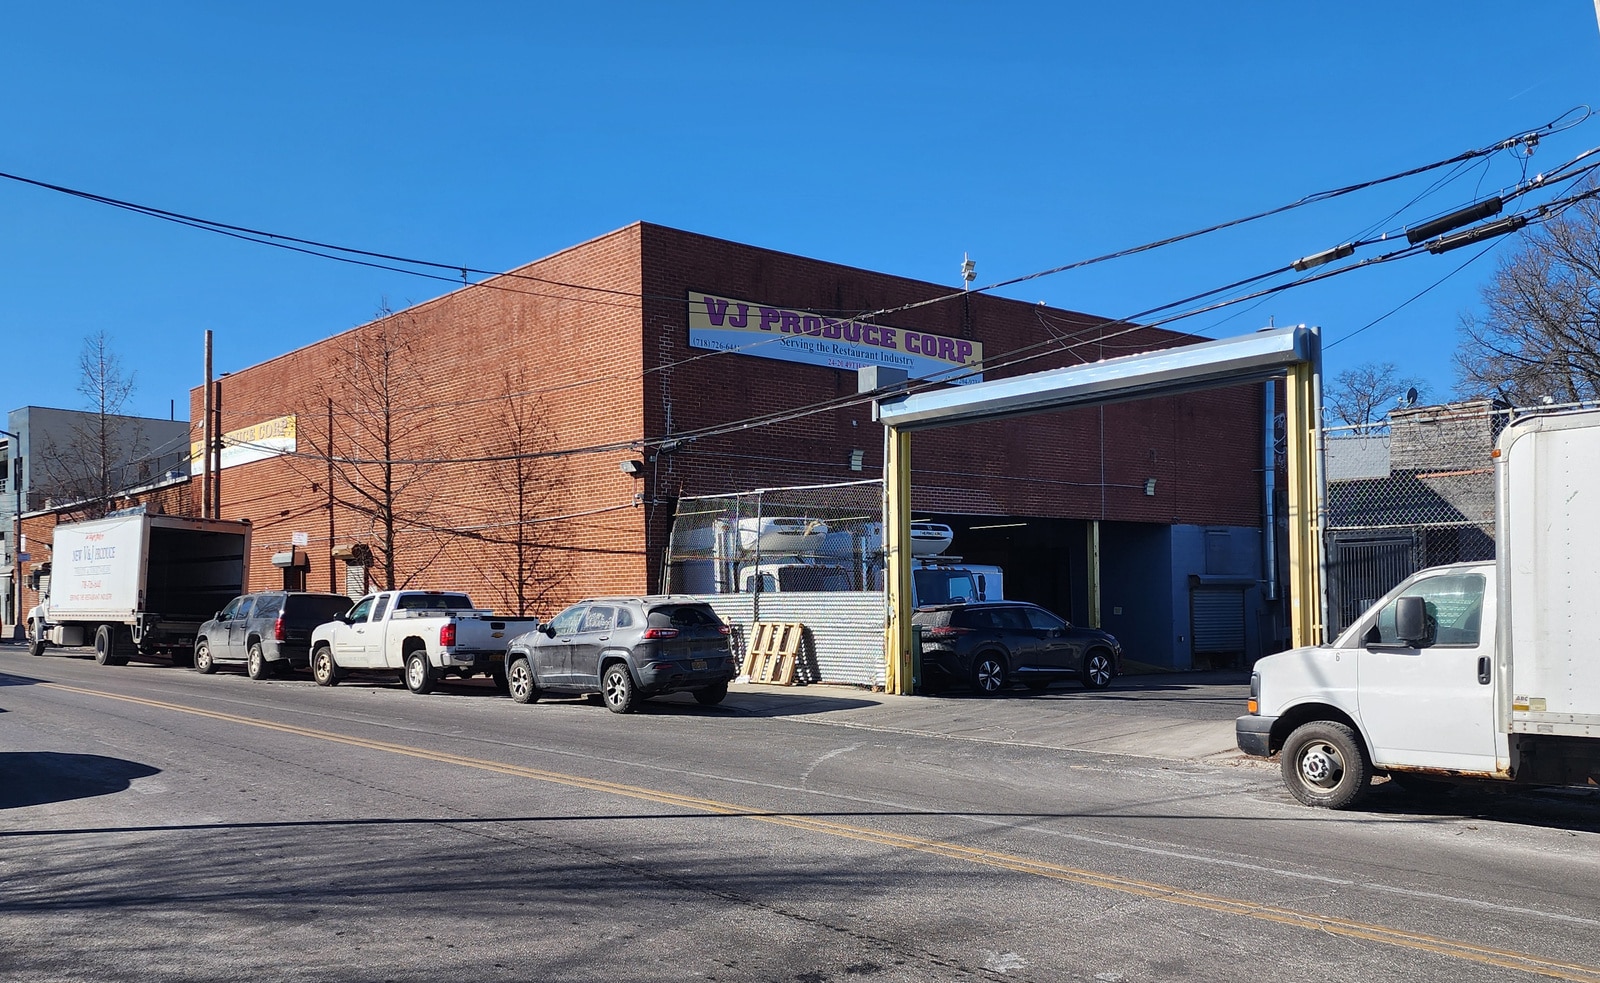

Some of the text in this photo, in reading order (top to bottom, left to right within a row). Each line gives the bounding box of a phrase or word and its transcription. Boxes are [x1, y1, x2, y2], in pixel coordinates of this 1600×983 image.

[704, 296, 749, 328] VJ
[759, 307, 896, 349] PRODUCE
[780, 335, 914, 366] Serving the Restaurant Industry
